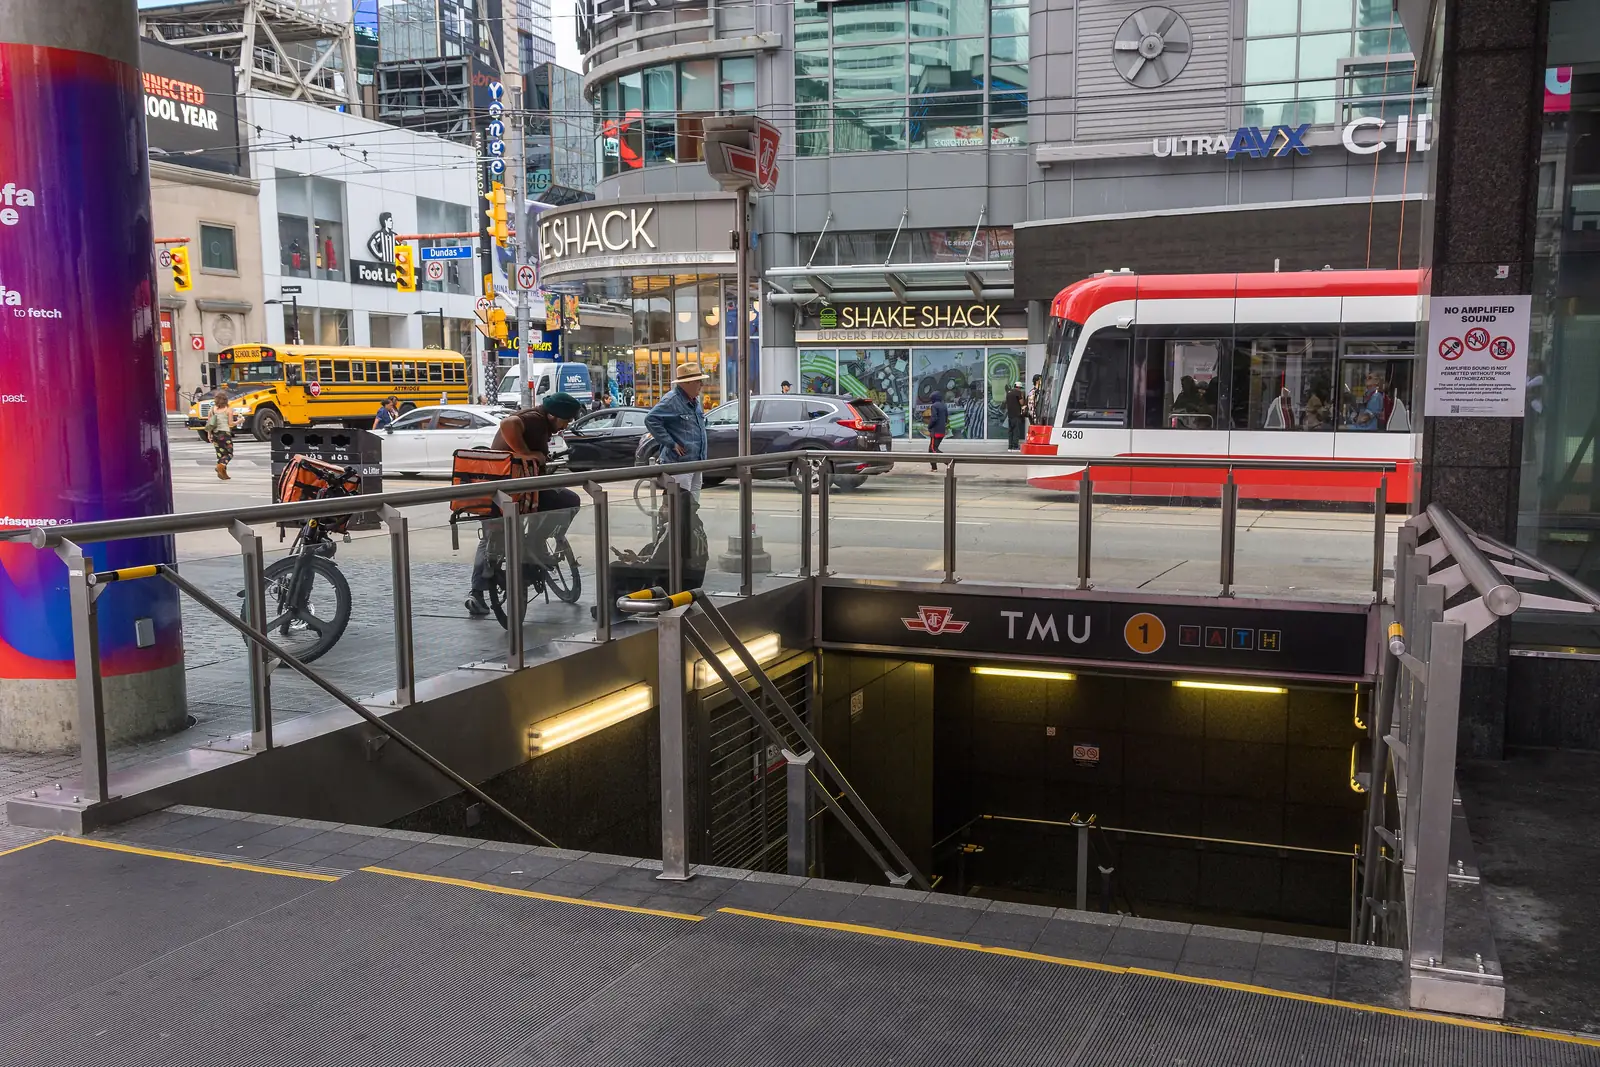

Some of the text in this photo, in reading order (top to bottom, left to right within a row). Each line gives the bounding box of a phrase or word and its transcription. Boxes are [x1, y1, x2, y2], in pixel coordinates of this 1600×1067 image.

[180, 103, 218, 131] YEAR
[488, 82, 505, 175] Yonge
[0, 183, 35, 206] fa
[553, 207, 656, 258] SHACK
[430, 248, 457, 257] Dundas
[685, 253, 714, 262] WINE
[359, 265, 418, 286] Foot Lor
[14, 308, 62, 318] to fetch
[842, 305, 1000, 328] SHAKE SHACK
[817, 330, 1004, 340] BURGERS FROZEN CUSTARD FRIES
[235, 350, 250, 358] SCHOOL
[2, 394, 27, 404] past.
[1062, 430, 1083, 439] 4630
[1000, 611, 1091, 644] TMU
[1138, 622, 1148, 644] 1
